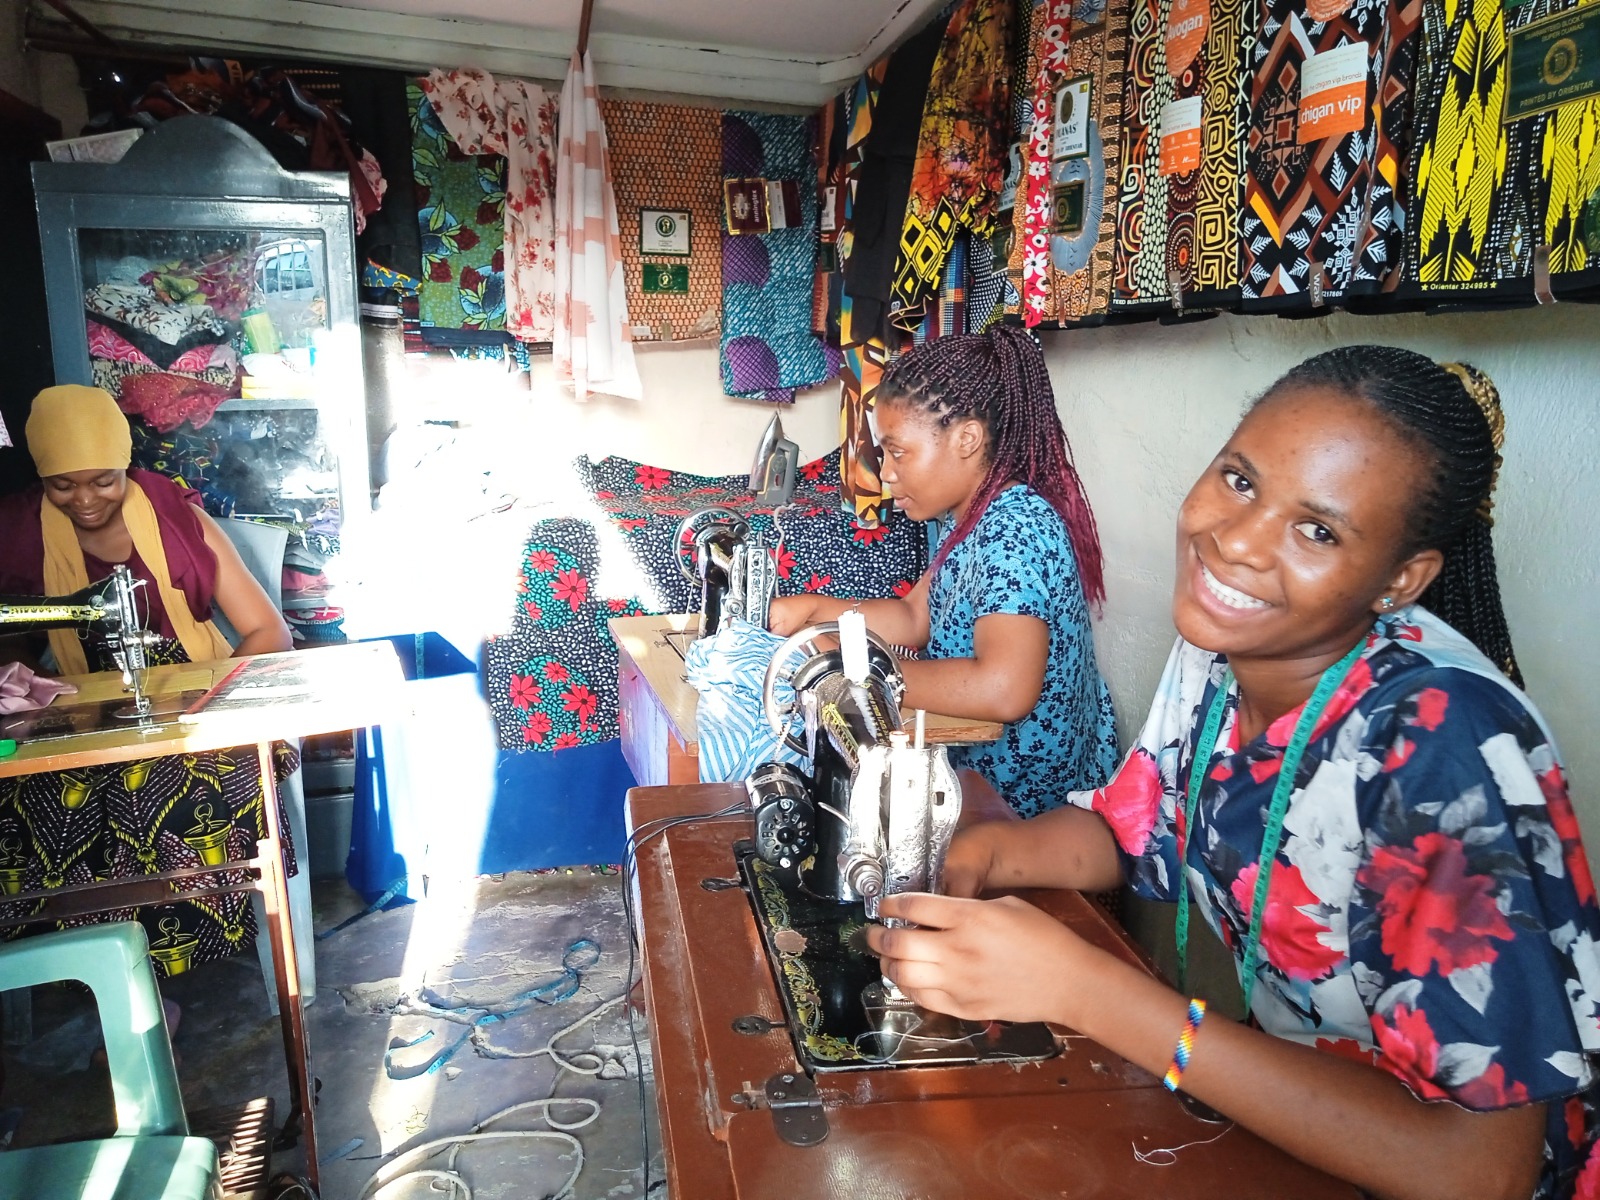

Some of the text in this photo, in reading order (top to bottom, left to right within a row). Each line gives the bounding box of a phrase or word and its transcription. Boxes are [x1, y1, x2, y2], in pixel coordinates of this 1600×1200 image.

[1547, 90, 1557, 100] BY
[1301, 94, 1362, 124] chigan vip
[1460, 281, 1488, 290] 324995
